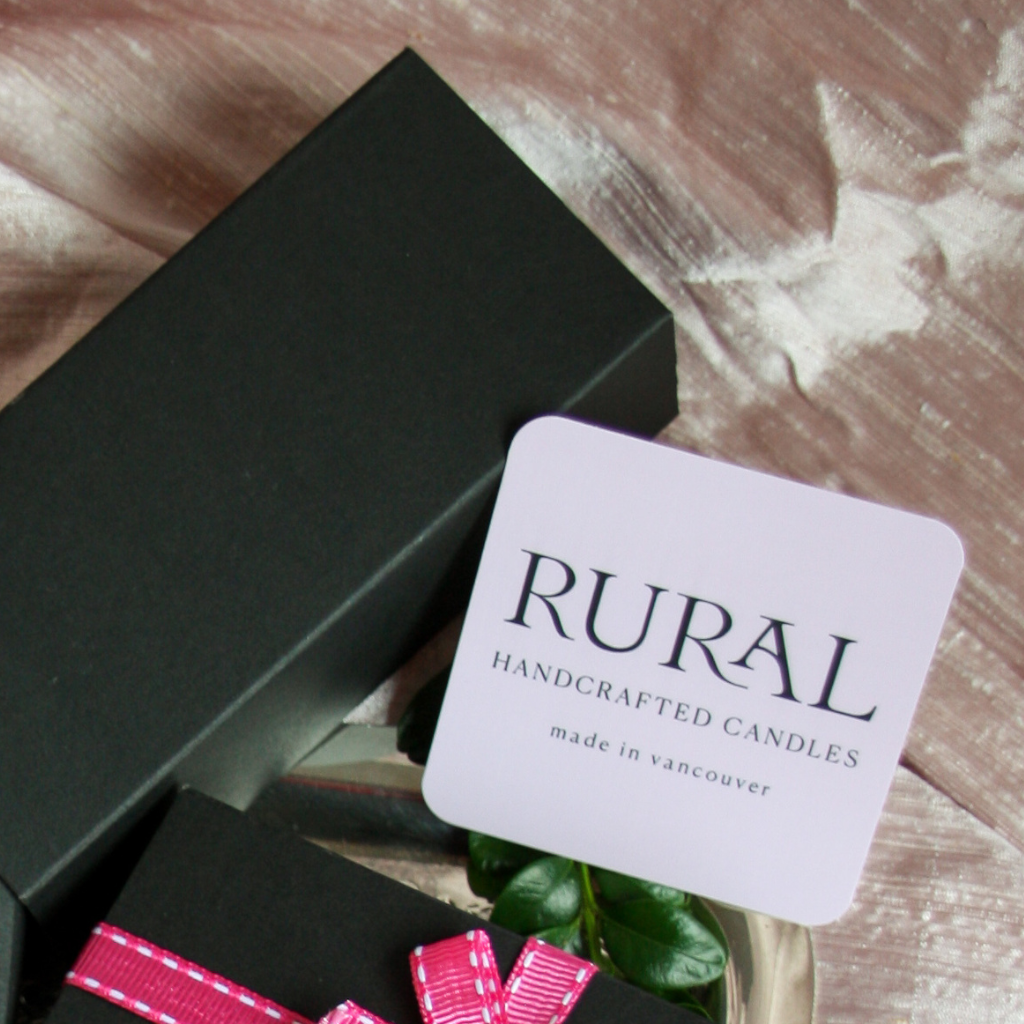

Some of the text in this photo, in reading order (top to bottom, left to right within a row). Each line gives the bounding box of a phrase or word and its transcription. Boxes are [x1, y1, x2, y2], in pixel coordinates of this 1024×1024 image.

[504, 549, 878, 722] RURAL
[491, 650, 861, 769] HANDCRAFTED CANDLES
[549, 725, 773, 797] made in vancouver
